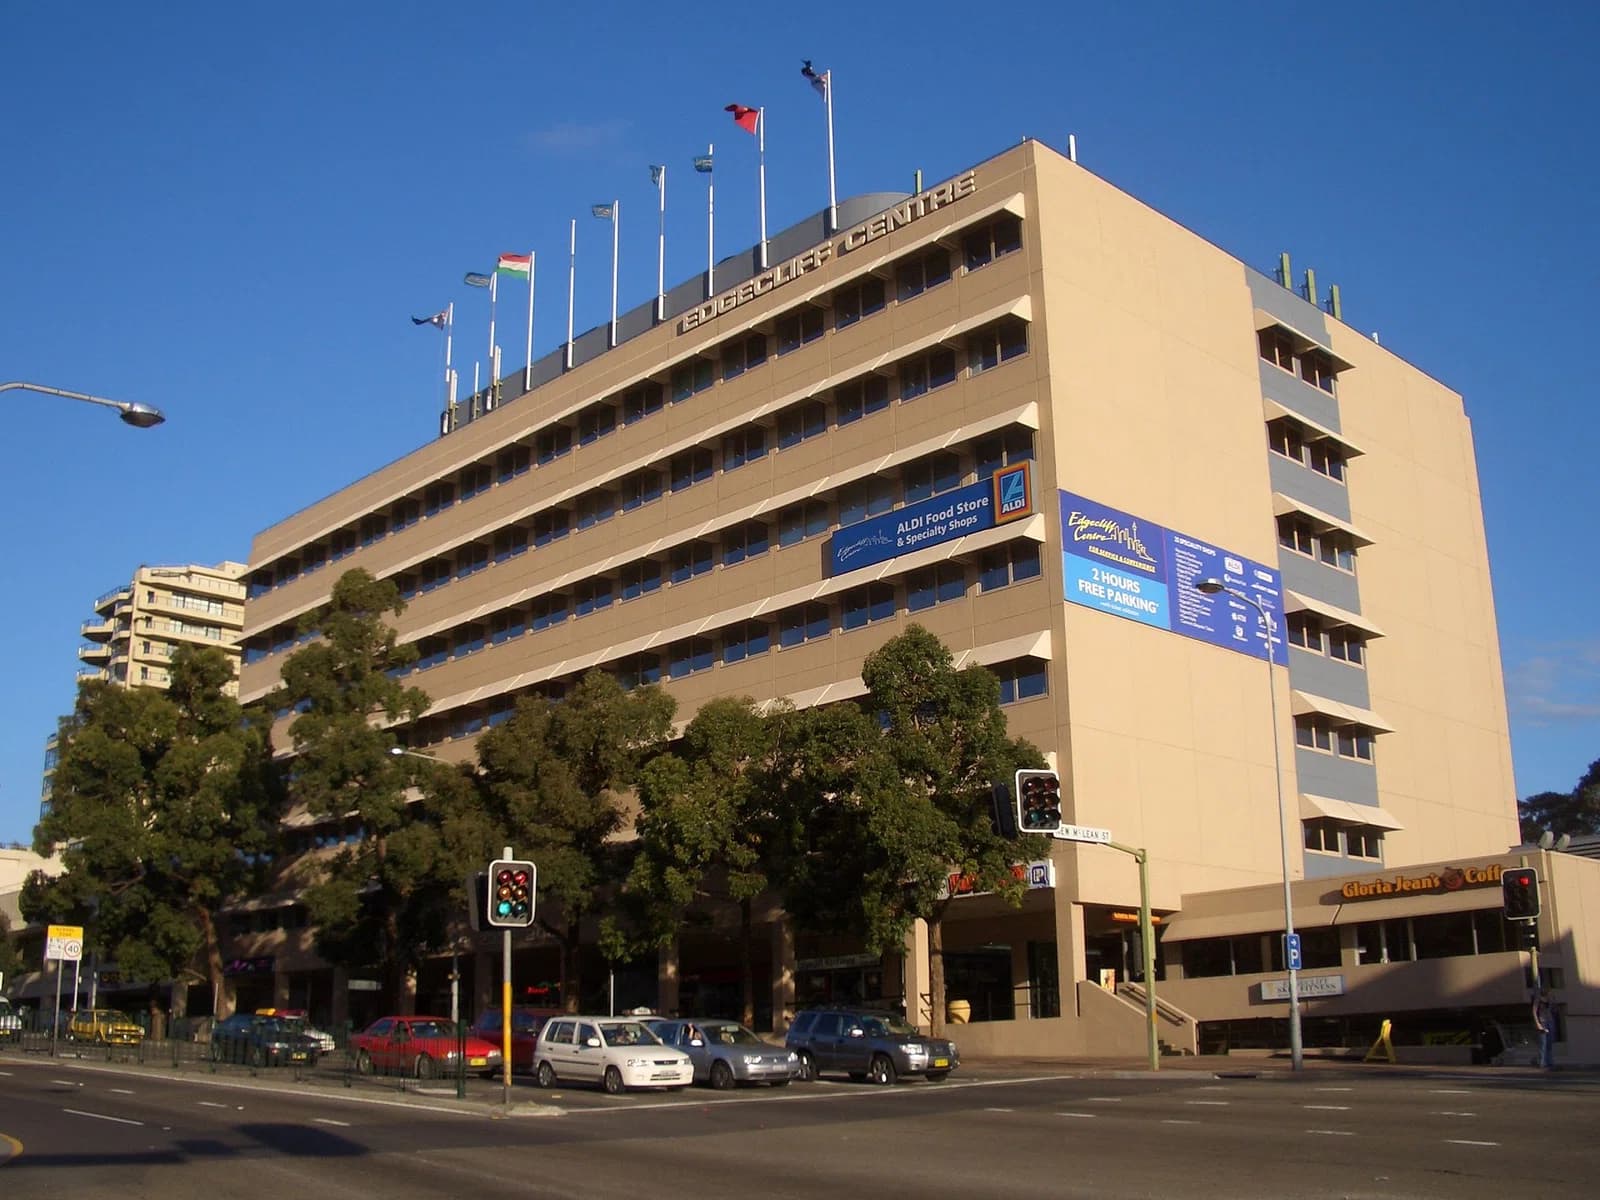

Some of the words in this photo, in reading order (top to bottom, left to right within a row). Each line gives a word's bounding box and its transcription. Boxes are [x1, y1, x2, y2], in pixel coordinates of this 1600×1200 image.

[681, 241, 833, 332] EDGECLIFF
[844, 170, 976, 251] CENTRE
[897, 519, 924, 534] ALDI
[925, 505, 954, 527] Food
[956, 496, 989, 516] Store
[1002, 498, 1025, 514] ALDI
[897, 538, 904, 547] &
[906, 523, 947, 545] Specialty
[949, 514, 978, 530] Shops
[1068, 511, 1116, 533] Edgecliff
[1073, 525, 1108, 541] Centre
[1078, 579, 1105, 599] FREE
[1091, 567, 1100, 581] 2
[1101, 570, 1141, 594] HOURS
[1342, 879, 1393, 898] Gloria
[1394, 873, 1441, 892] Jean's
[1464, 864, 1503, 884] Coff
[67, 944, 79, 953] 40
[1290, 948, 1299, 965] P
